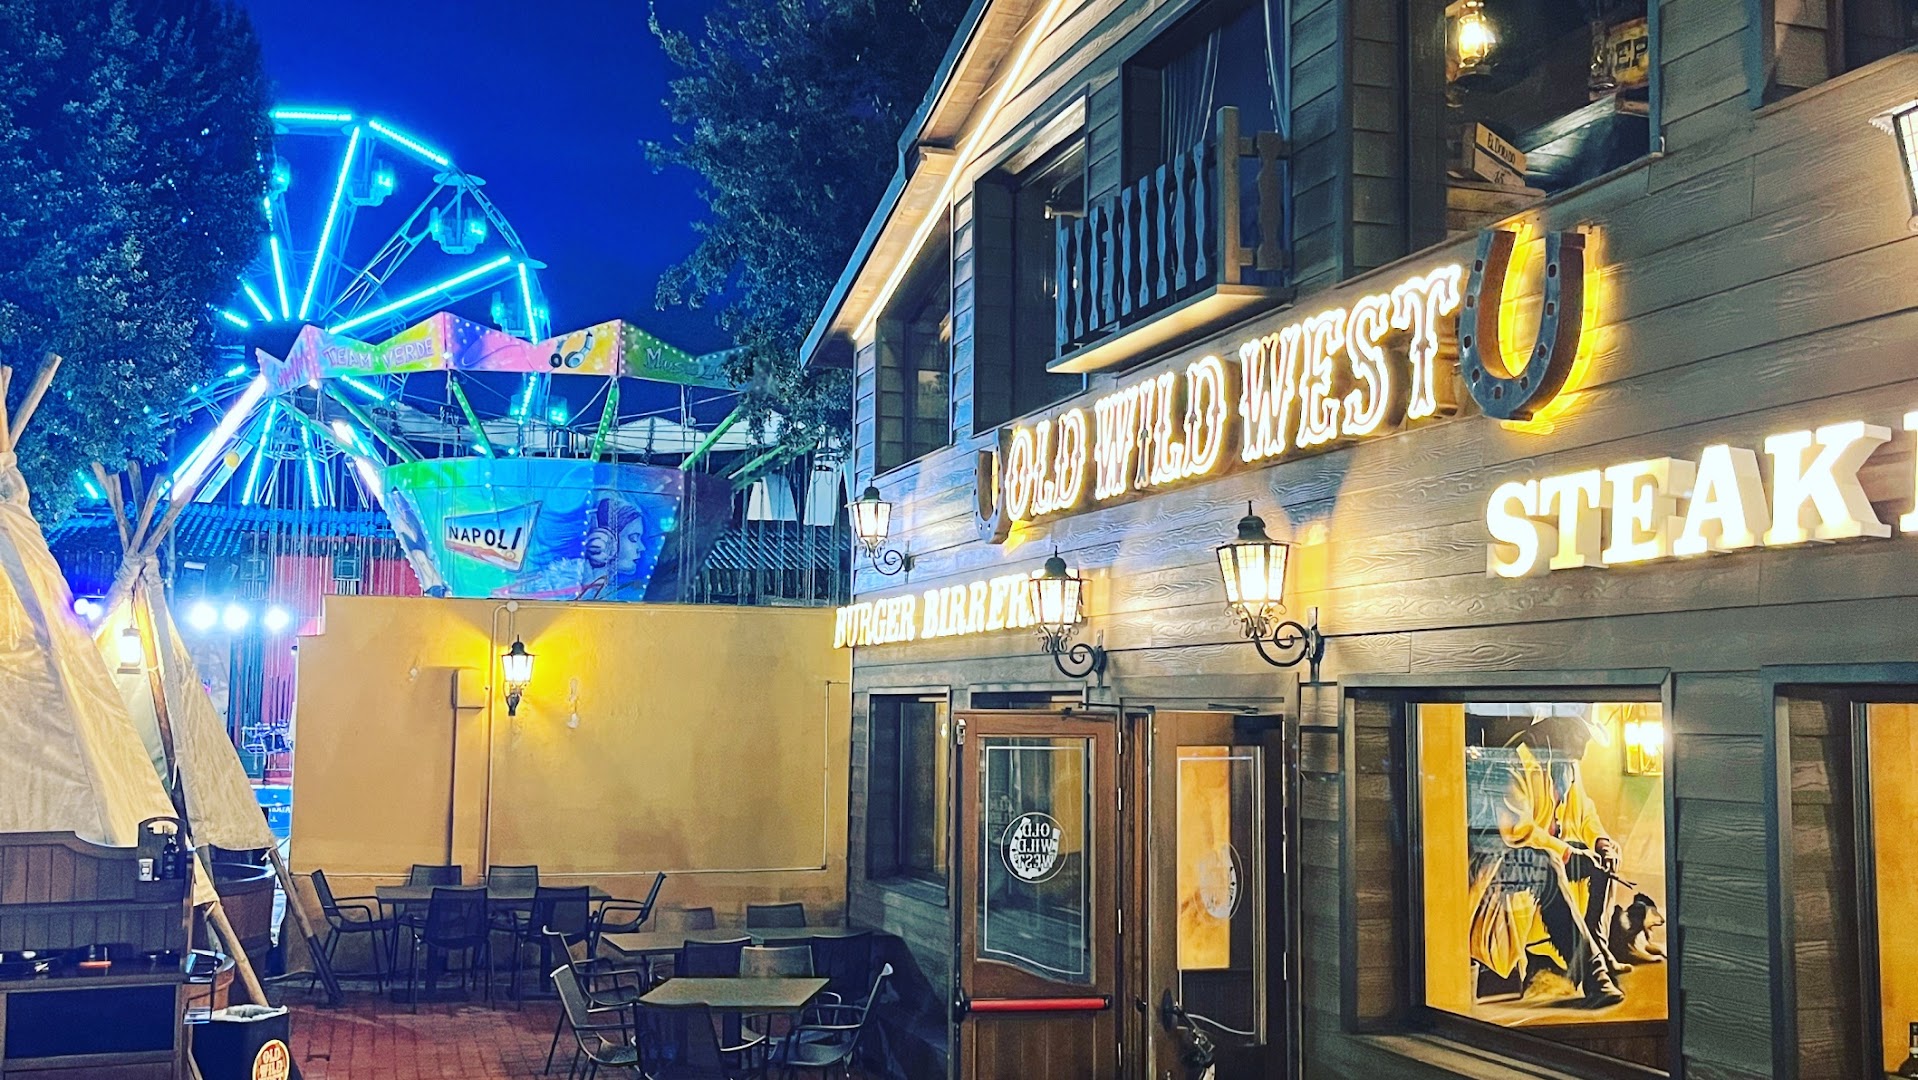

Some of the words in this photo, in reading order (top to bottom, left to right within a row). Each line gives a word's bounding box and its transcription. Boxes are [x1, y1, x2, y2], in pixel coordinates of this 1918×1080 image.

[324, 346, 373, 369] TEAM
[382, 337, 434, 368] VERDE
[1005, 407, 1087, 522] OLD
[1094, 356, 1227, 500] WILD
[1239, 264, 1462, 463] WEST
[1486, 420, 1892, 579] STEAK
[448, 526, 522, 550] NAPOLI
[833, 594, 916, 649] BURGER
[259, 1060, 284, 1078] WILD
[262, 1047, 281, 1064] OLD
